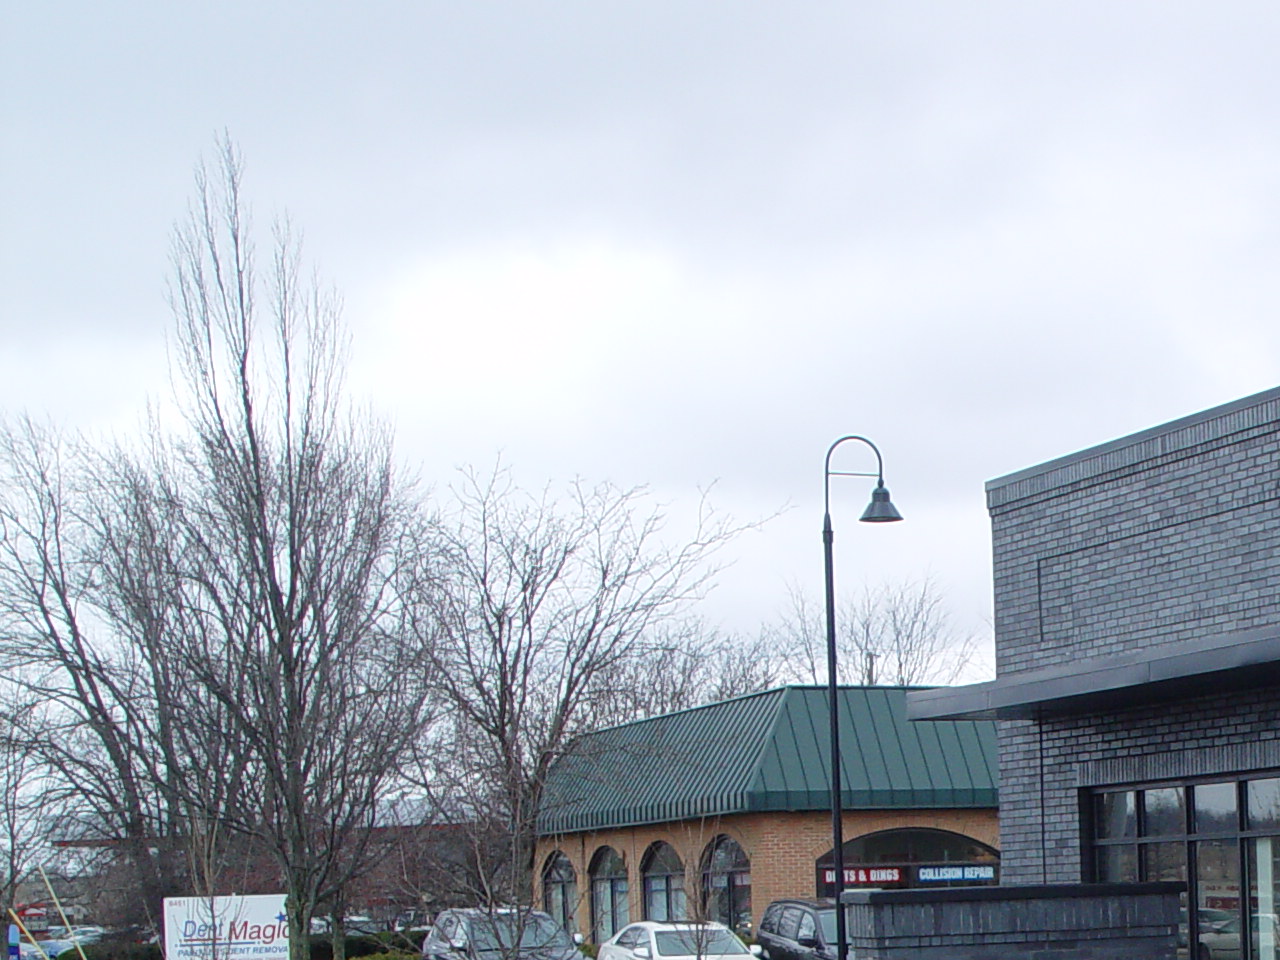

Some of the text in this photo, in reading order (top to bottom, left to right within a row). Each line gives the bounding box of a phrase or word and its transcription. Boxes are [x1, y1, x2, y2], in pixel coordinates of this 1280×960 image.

[825, 868, 856, 882] DTS
[870, 868, 899, 881] DINGS
[919, 866, 994, 880] COLLISION REPAIR
